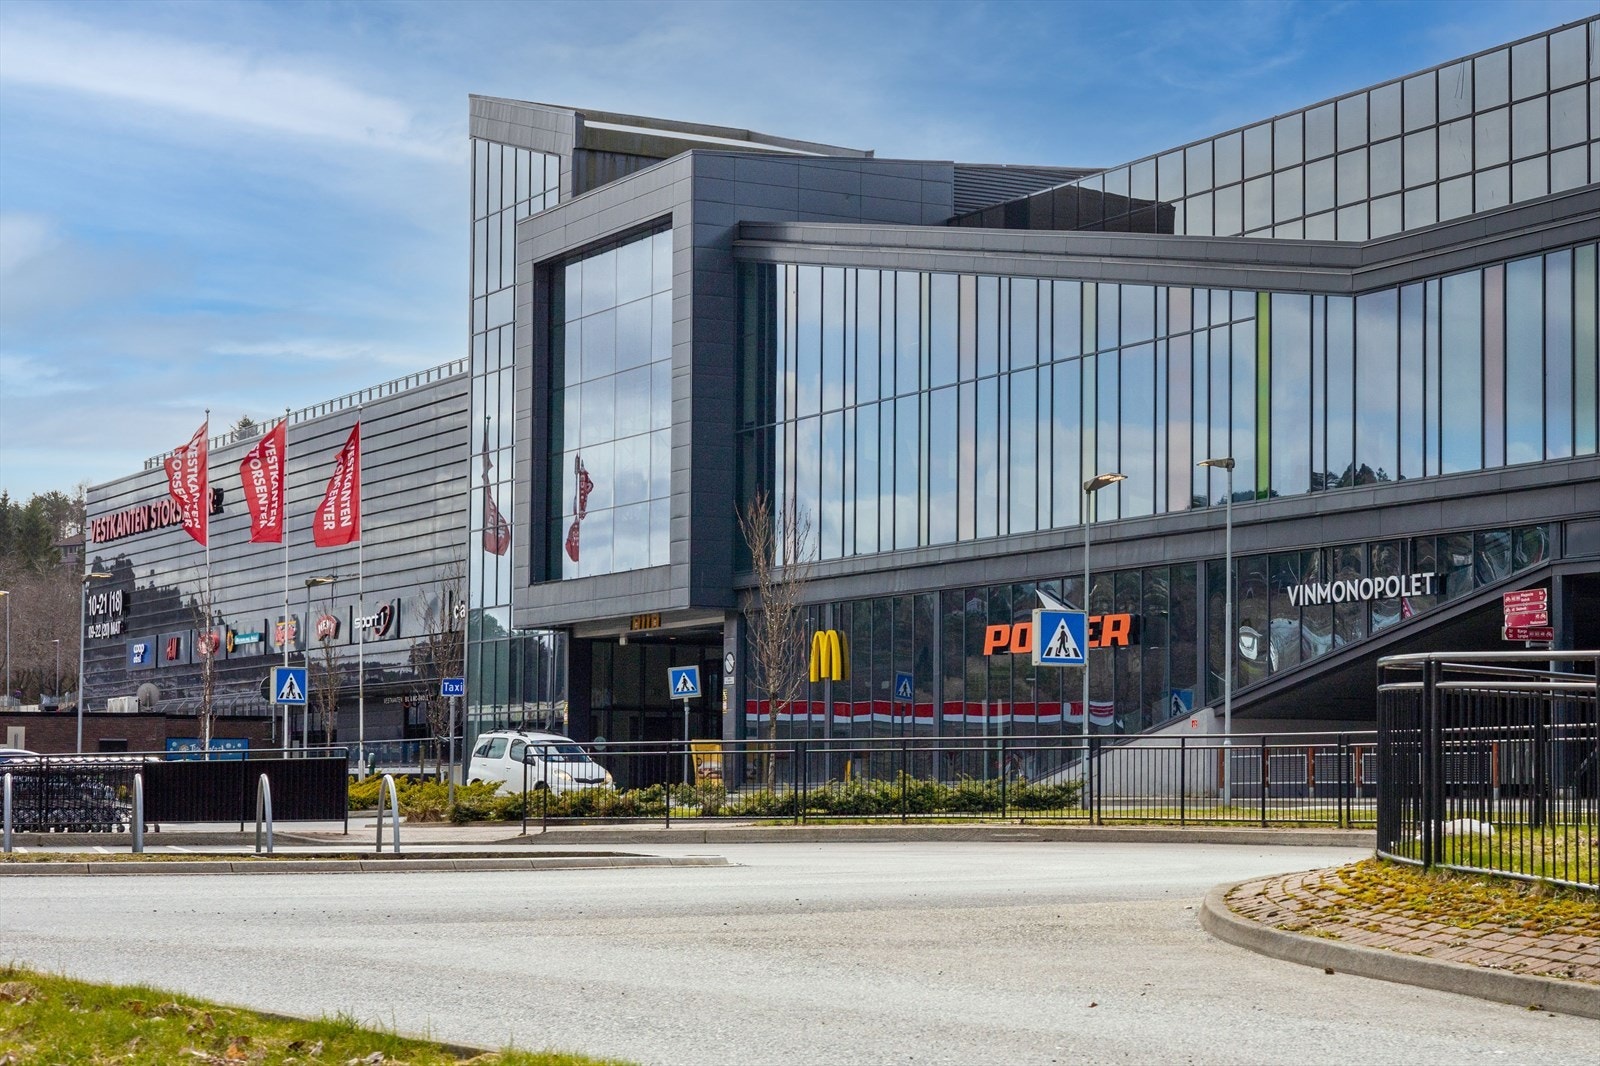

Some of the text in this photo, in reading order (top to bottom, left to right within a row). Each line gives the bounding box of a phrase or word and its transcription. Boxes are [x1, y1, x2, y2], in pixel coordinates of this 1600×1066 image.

[264, 438, 279, 527] VESTKANTEN
[340, 440, 356, 528] VESTKANTEN
[90, 504, 149, 543] VESTKANTEN
[88, 590, 122, 617] 10-21 (18)
[1287, 572, 1435, 607] VINMONOPOLET
[983, 613, 1131, 656] POER
[443, 682, 463, 692] Taxi
